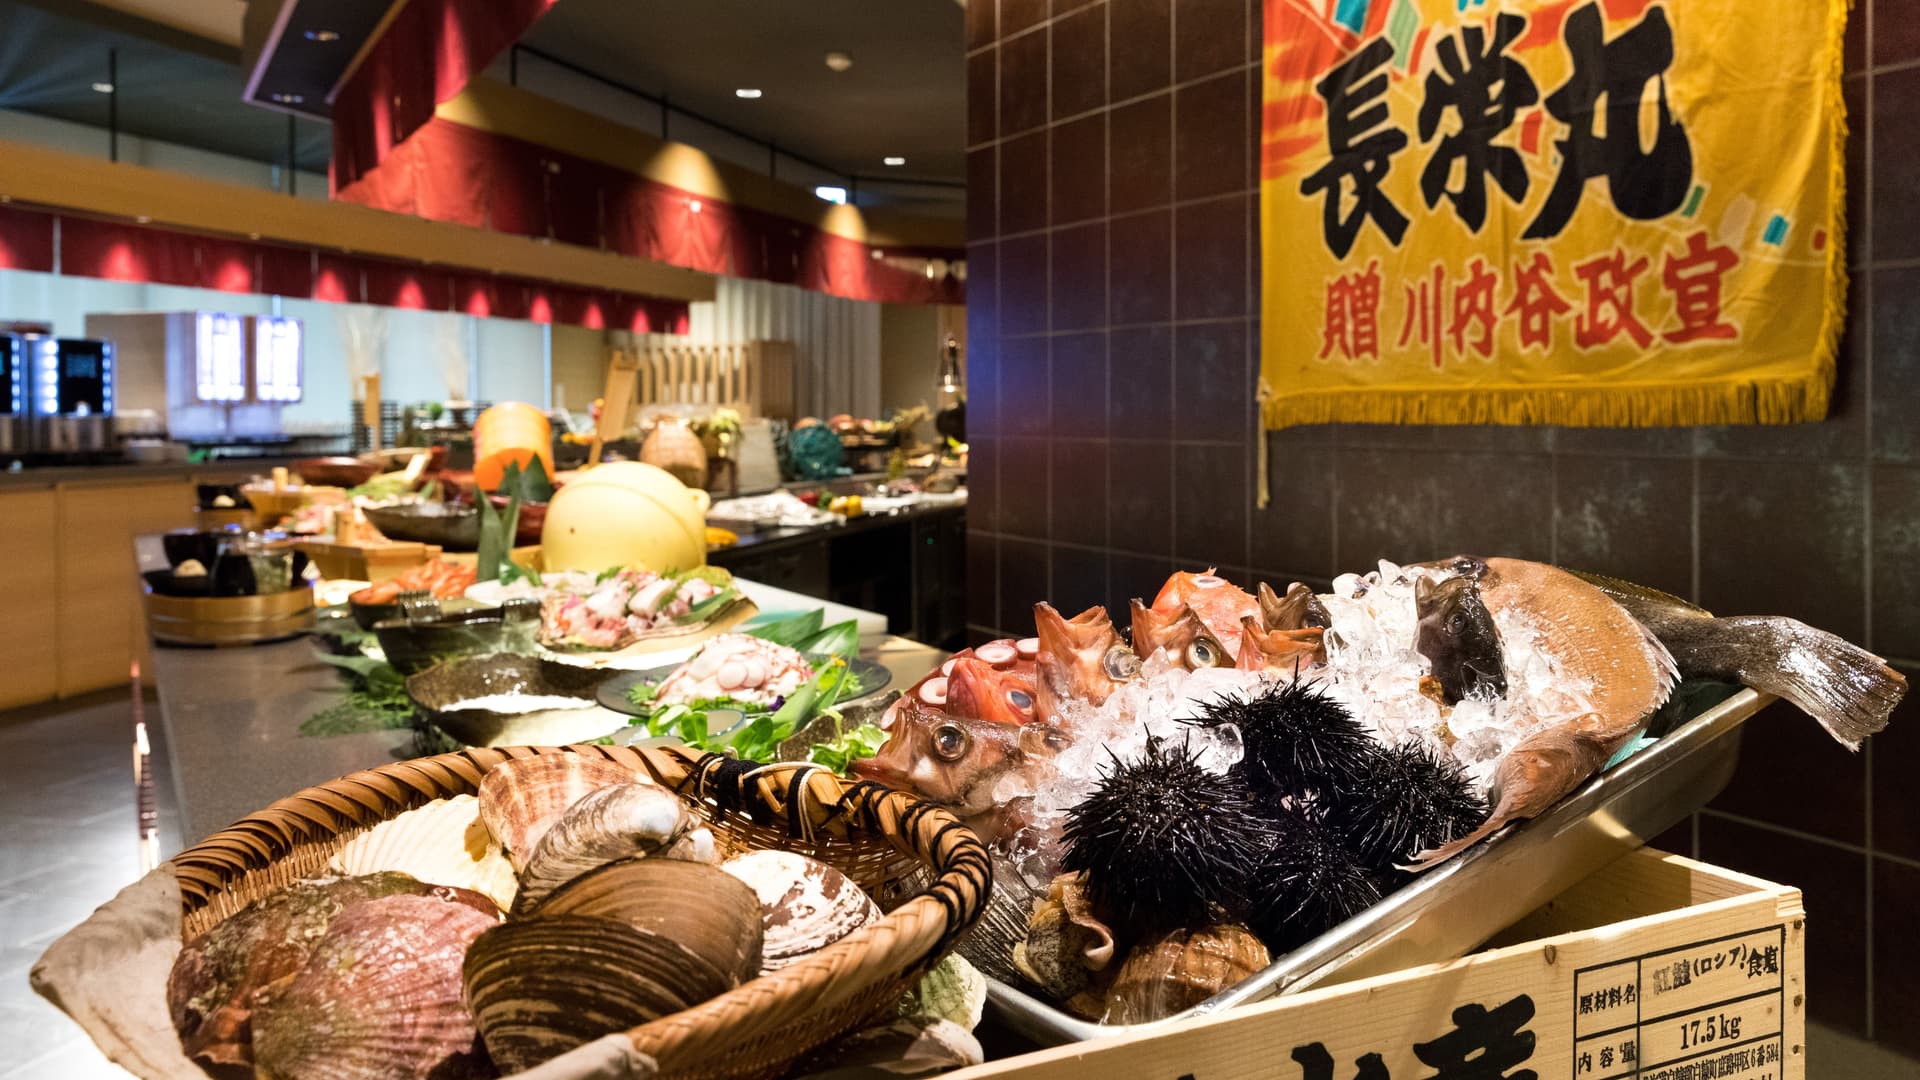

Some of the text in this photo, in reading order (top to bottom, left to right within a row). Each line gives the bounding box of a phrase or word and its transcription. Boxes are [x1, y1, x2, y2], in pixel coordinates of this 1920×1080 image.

[1299, 0, 1694, 261] 長栄丸
[1578, 983, 1636, 1015] 原材料名
